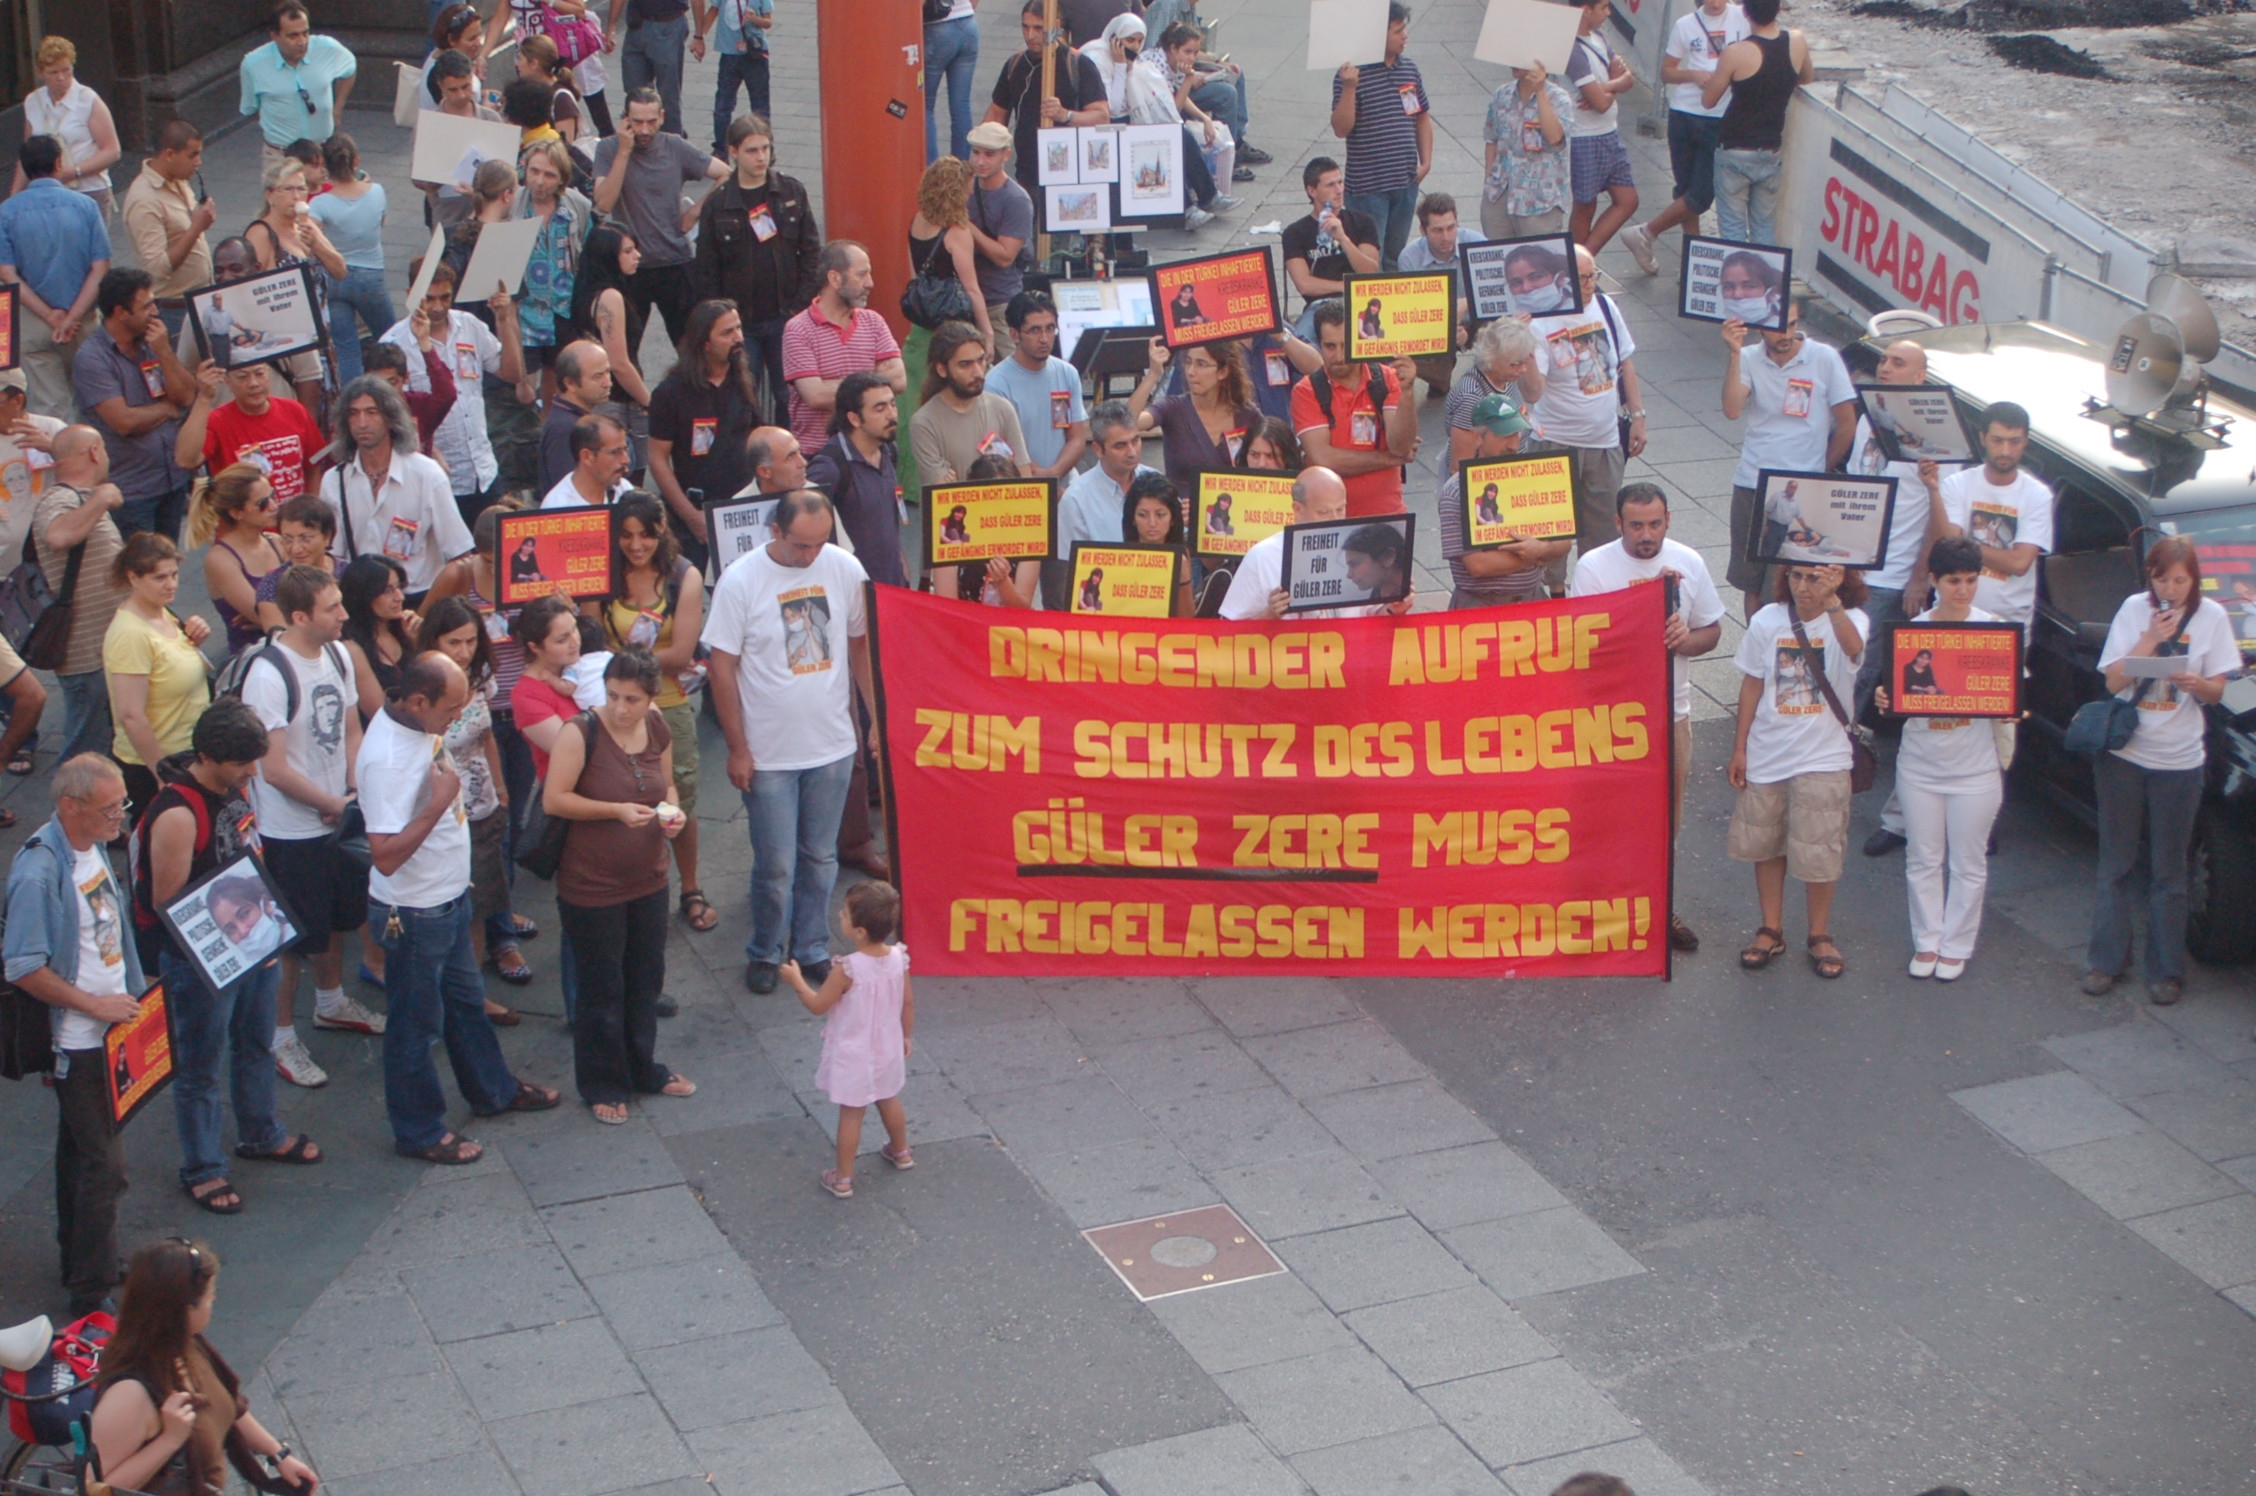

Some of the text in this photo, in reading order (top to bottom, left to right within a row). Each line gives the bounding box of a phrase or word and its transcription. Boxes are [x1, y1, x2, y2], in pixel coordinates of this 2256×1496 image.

[1820, 176, 1981, 326] STRABAG
[1160, 272, 1172, 288] DIE
[1181, 268, 1194, 284] DER
[1195, 264, 1219, 280] TÜRKEI
[1220, 257, 1262, 276] INHAFTIERTE
[252, 278, 296, 296] GÜLER ZERE
[1356, 284, 1366, 296] WIR
[1368, 282, 1392, 296] WERDEN
[1394, 281, 1411, 294] NICHT
[270, 302, 292, 312] Vater
[1228, 294, 1268, 314] GÜLER ZERE
[1393, 308, 1444, 324] DASS GÜLER ZERE
[1174, 326, 1193, 342] MUSS
[1193, 318, 1241, 338] FREIGELASSEN
[1356, 343, 1363, 356] IM
[1364, 340, 1398, 356] GEFÄNGNIS
[1400, 338, 1430, 354] ERMORDET
[1471, 460, 1564, 482] WIR WERDEN NICHT ZULASSEN,
[1204, 477, 1294, 495] WIR WERDEN NICHT ZULASS
[1830, 488, 1879, 500] GÜLER ZERE
[936, 492, 950, 504] WIR
[951, 490, 980, 504] WERDEN
[982, 488, 1003, 501] NICHT
[1511, 490, 1566, 508] DASS GÜLER ZERE
[1830, 502, 1877, 510] mit ihrem
[723, 508, 760, 530] FREIHEIT
[980, 512, 1042, 528] DASS GÜLER ZERE
[1244, 508, 1294, 526] DASS GÜLER ZE
[1840, 512, 1866, 521] Vater
[736, 533, 754, 552] FÜR
[1202, 537, 1210, 550] IM
[1302, 532, 1340, 552] FREIHEIT
[1474, 529, 1482, 542] IM
[937, 548, 946, 559] IM
[946, 544, 986, 558] GEFÄNGNIS
[988, 542, 1025, 556] ERMORDET
[1081, 552, 1092, 565] WIR
[1092, 552, 1116, 566] WERDEN
[1118, 553, 1136, 567] NICHT
[1310, 555, 1328, 574] FÜR
[1112, 581, 1165, 600] DASS GÜLER ZERE
[1294, 579, 1342, 599] GÜLER ZERE
[1897, 634, 1910, 649] DIE
[1920, 634, 1934, 649] DER
[1936, 632, 1963, 649] TÜRKEI
[1964, 634, 2011, 650] INHAFTIERTE
[988, 612, 1610, 689] DRINGENDER AUFRUF
[1966, 672, 2010, 692] GÜLER ZERE
[1777, 704, 1824, 714] GÜLER ZERE
[1902, 694, 1922, 710] MUSS
[1924, 695, 1977, 710] FREIGELASSEN
[914, 701, 1649, 779] ZUM SCHUTZ DES LEBENS
[1012, 796, 1571, 869] GÜLER ZERE MUSS
[949, 896, 1651, 959] FREIGELASSEN WERDEN!
